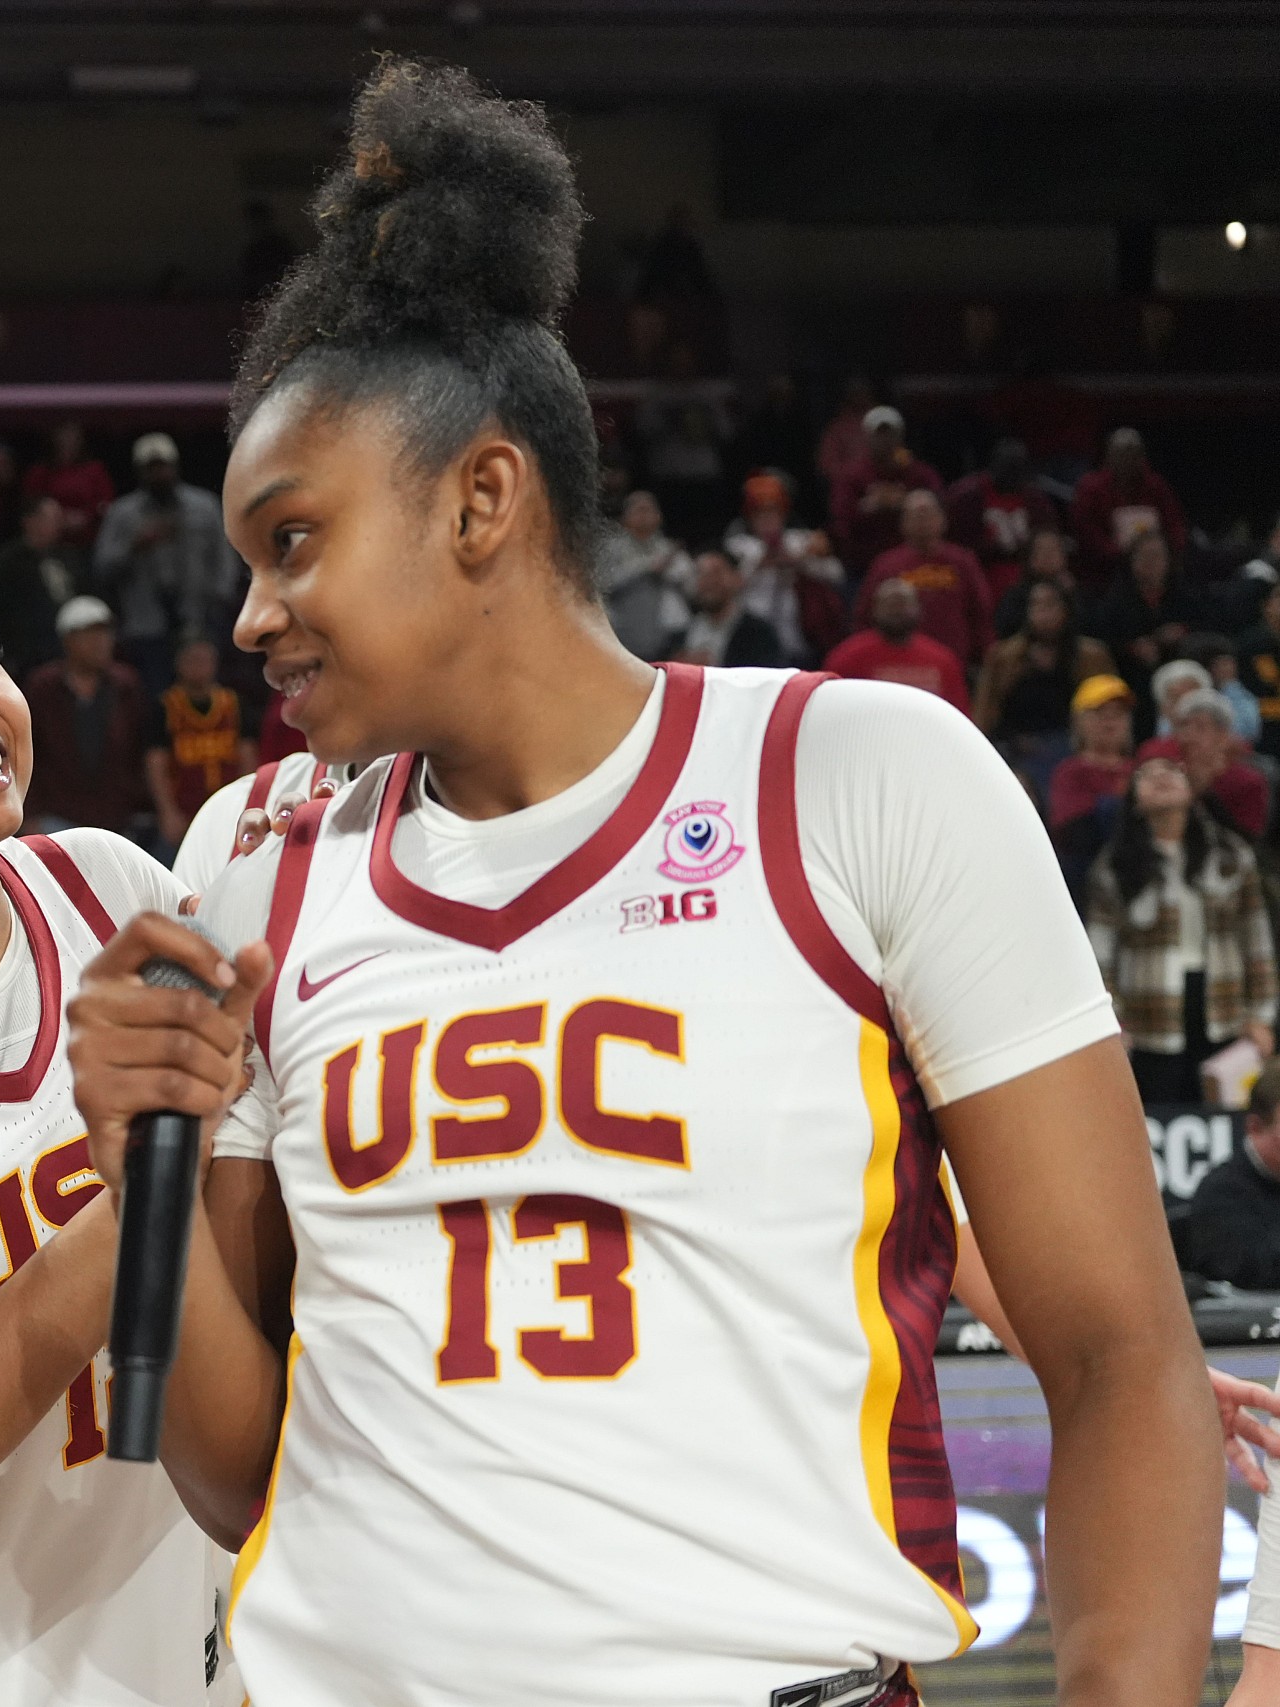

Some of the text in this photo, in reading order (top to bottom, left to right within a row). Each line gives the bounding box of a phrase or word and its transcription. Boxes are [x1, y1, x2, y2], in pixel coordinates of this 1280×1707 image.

[320, 996, 692, 1195] USC
[435, 1193, 639, 1387] 13
[62, 1360, 114, 1471] 1
